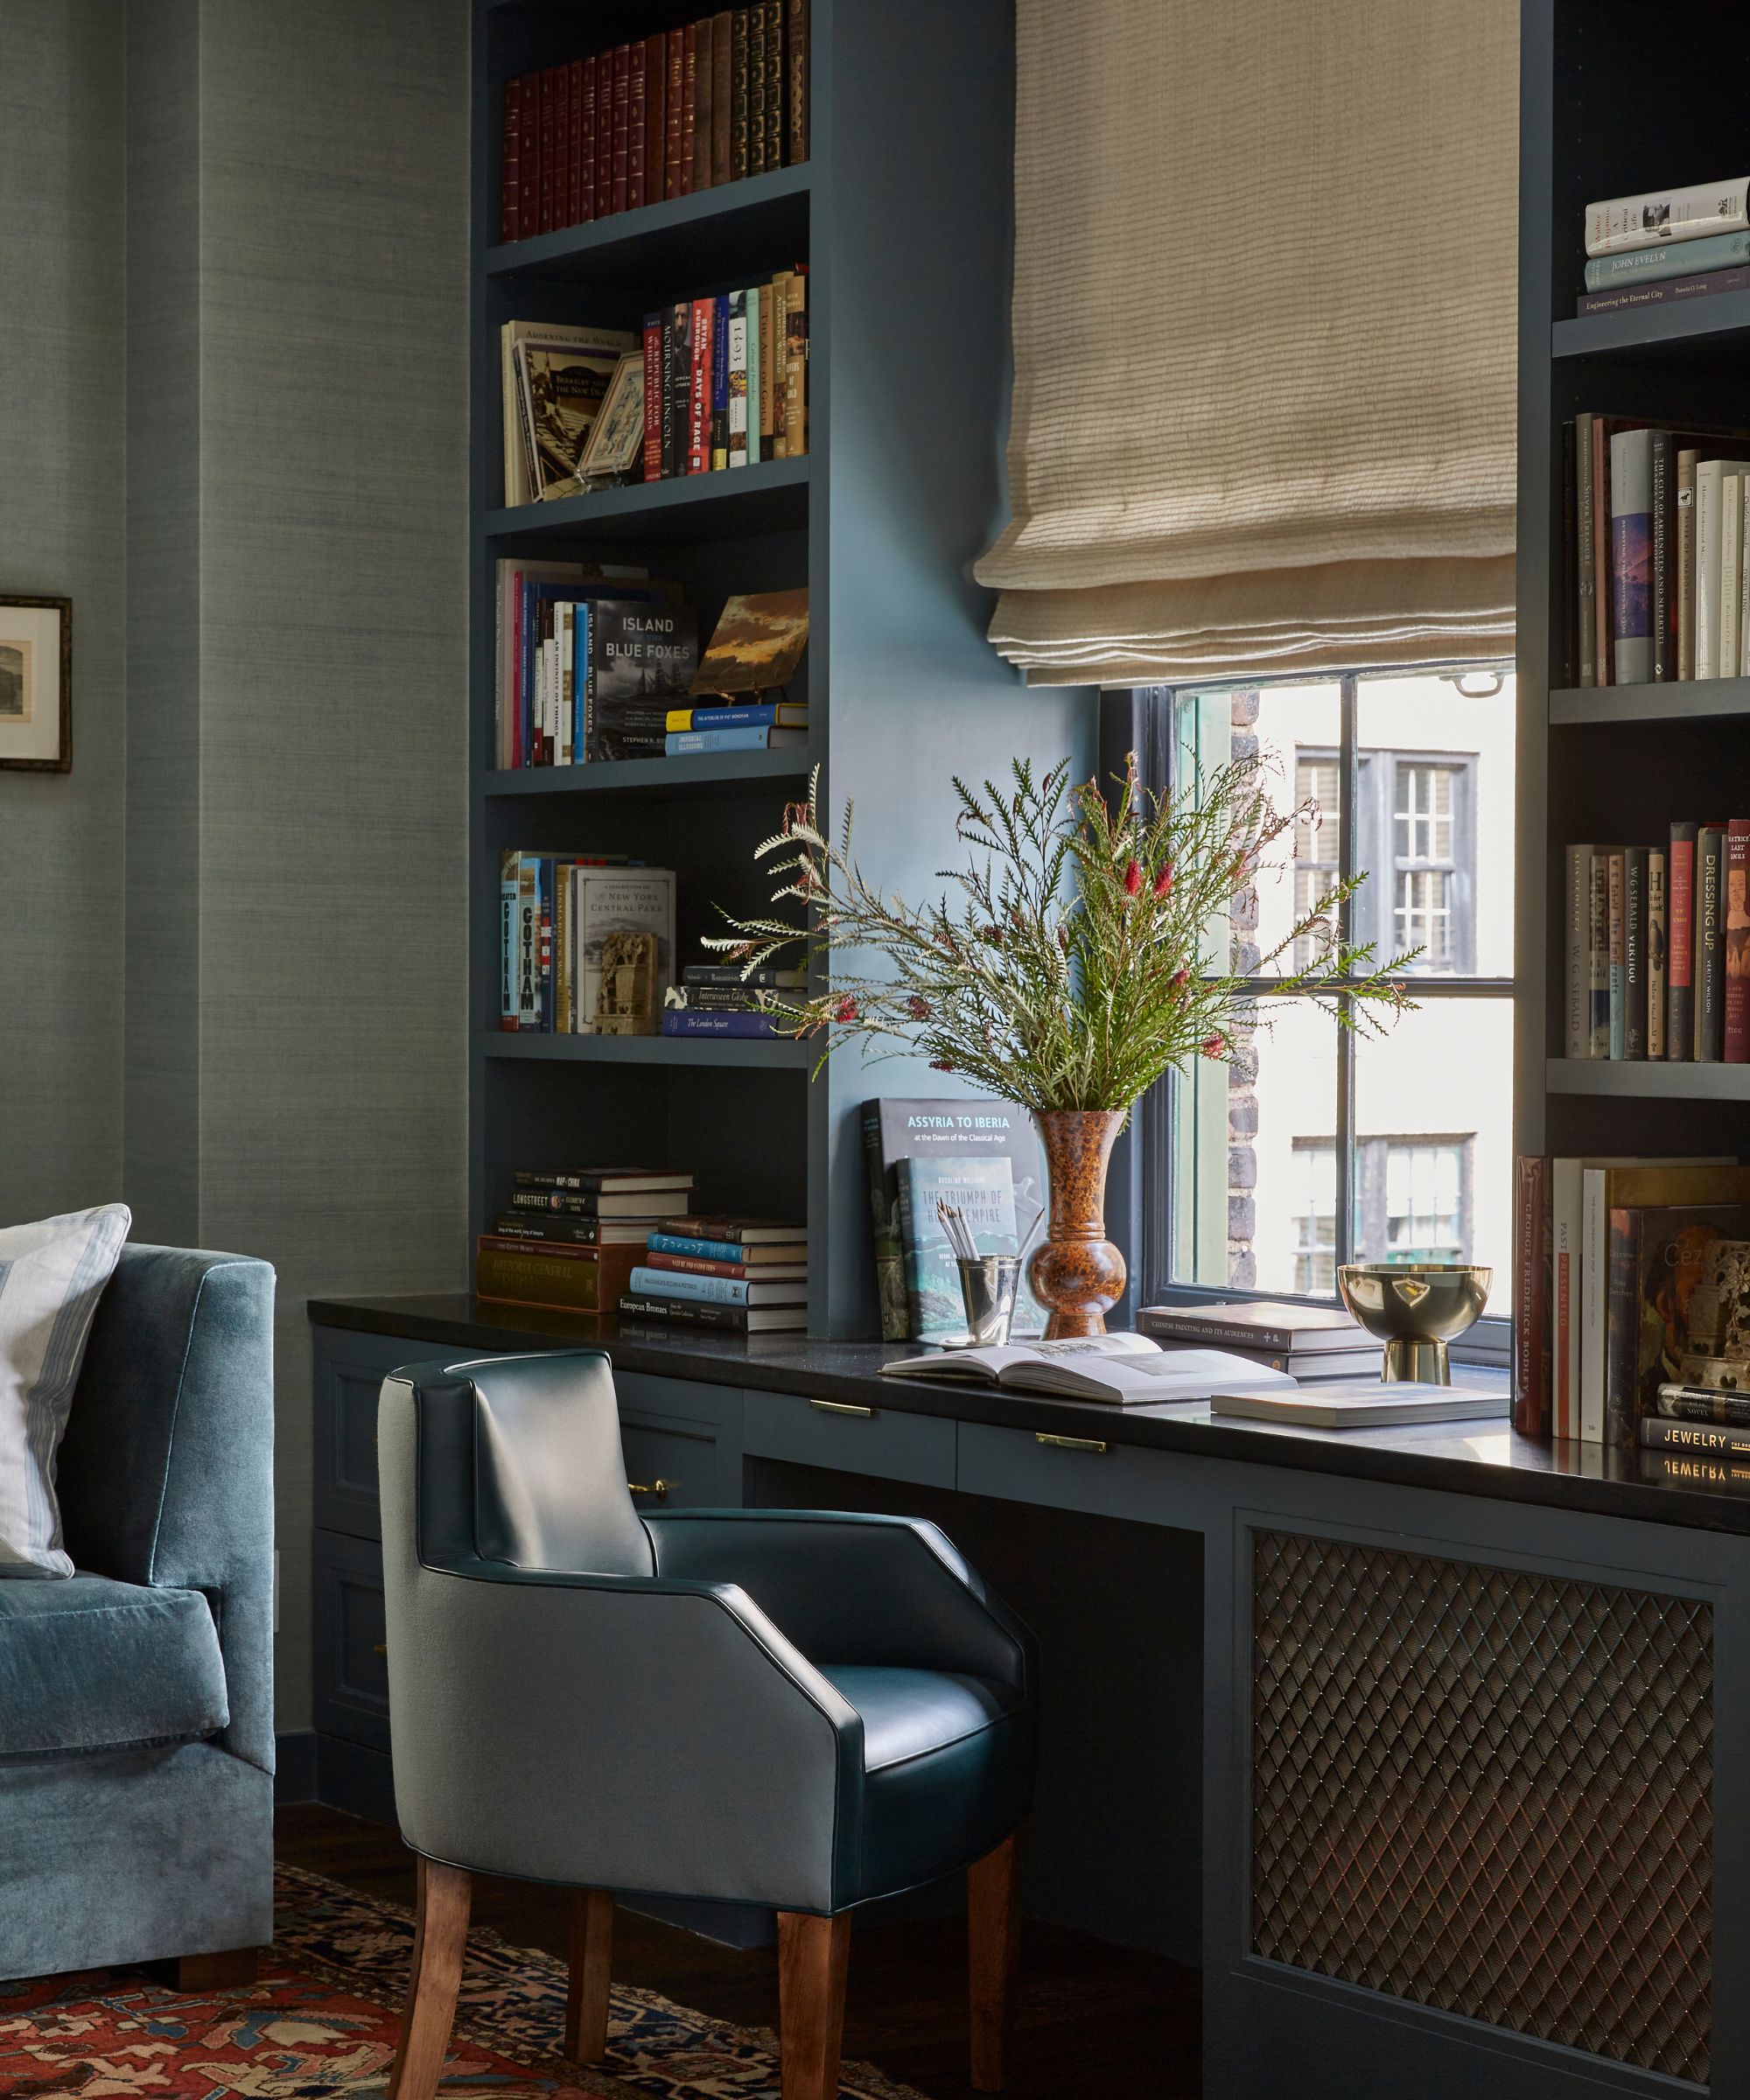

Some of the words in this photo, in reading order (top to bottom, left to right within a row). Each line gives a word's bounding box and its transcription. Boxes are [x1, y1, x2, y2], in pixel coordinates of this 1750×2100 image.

[1611, 257, 1634, 273] JOHN
[1634, 252, 1667, 265] EVELYN
[1586, 298, 1619, 310] Engineering
[1629, 293, 1650, 302] Eternal
[1651, 290, 1663, 299] City
[526, 331, 571, 343] ADORNING
[574, 335, 591, 345] THE
[732, 326, 742, 362] 1493
[695, 369, 704, 398] DAYS
[760, 372, 767, 387] OF
[694, 402, 702, 416] OF
[1658, 503, 1664, 515] OF
[1584, 518, 1592, 567] TREASURE
[1684, 543, 1690, 554] OF
[623, 616, 674, 632] ISLAND
[554, 640, 560, 652] AN
[606, 642, 642, 657] BLUE
[647, 644, 690, 659] FOXES
[554, 693, 559, 703] OF
[1649, 872, 1662, 891] H
[609, 892, 630, 901] NEW
[634, 892, 659, 902] YORK
[1572, 853, 1581, 932] AUSTERLITZ
[1705, 854, 1716, 927] DRESSING
[591, 903, 635, 912] CENTRAL
[638, 904, 663, 913] PARK
[1611, 916, 1620, 934] The
[1704, 931, 1715, 951] UP
[521, 907, 534, 1011] GOTHAM
[1572, 944, 1580, 959] W.
[1572, 964, 1580, 977] G.
[1609, 941, 1620, 995] Emigrants
[1572, 983, 1580, 1032] SEBALD
[687, 1018, 696, 1027] The
[696, 1018, 713, 1027] London
[713, 1018, 729, 1031] Square
[907, 1116, 955, 1128] ASSYRIA
[956, 1116, 972, 1128] TO
[975, 1116, 1010, 1129] IBERIA
[993, 1135, 1006, 1144] Age
[513, 1193, 549, 1207] LONGSTREET
[923, 1190, 939, 1205] THE
[945, 1190, 986, 1205] TRIUMPH
[991, 1190, 1002, 1205] OF
[966, 1208, 1001, 1223] EMPIRE
[1559, 1222, 1568, 1250] PAST
[533, 1264, 573, 1278] GENERAL
[1559, 1255, 1568, 1327] PRESENTED
[620, 1298, 645, 1313] European
[646, 1302, 668, 1314] Bronzes
[1152, 1321, 1174, 1330] CHINESE
[1175, 1323, 1200, 1334] PAINTING
[1200, 1326, 1214, 1335] AND
[1214, 1328, 1223, 1337] ITS
[1223, 1329, 1254, 1340] AUDIENCES
[1687, 1407, 1709, 1417] NOVEL
[1664, 1429, 1726, 1449] JEWELRY
